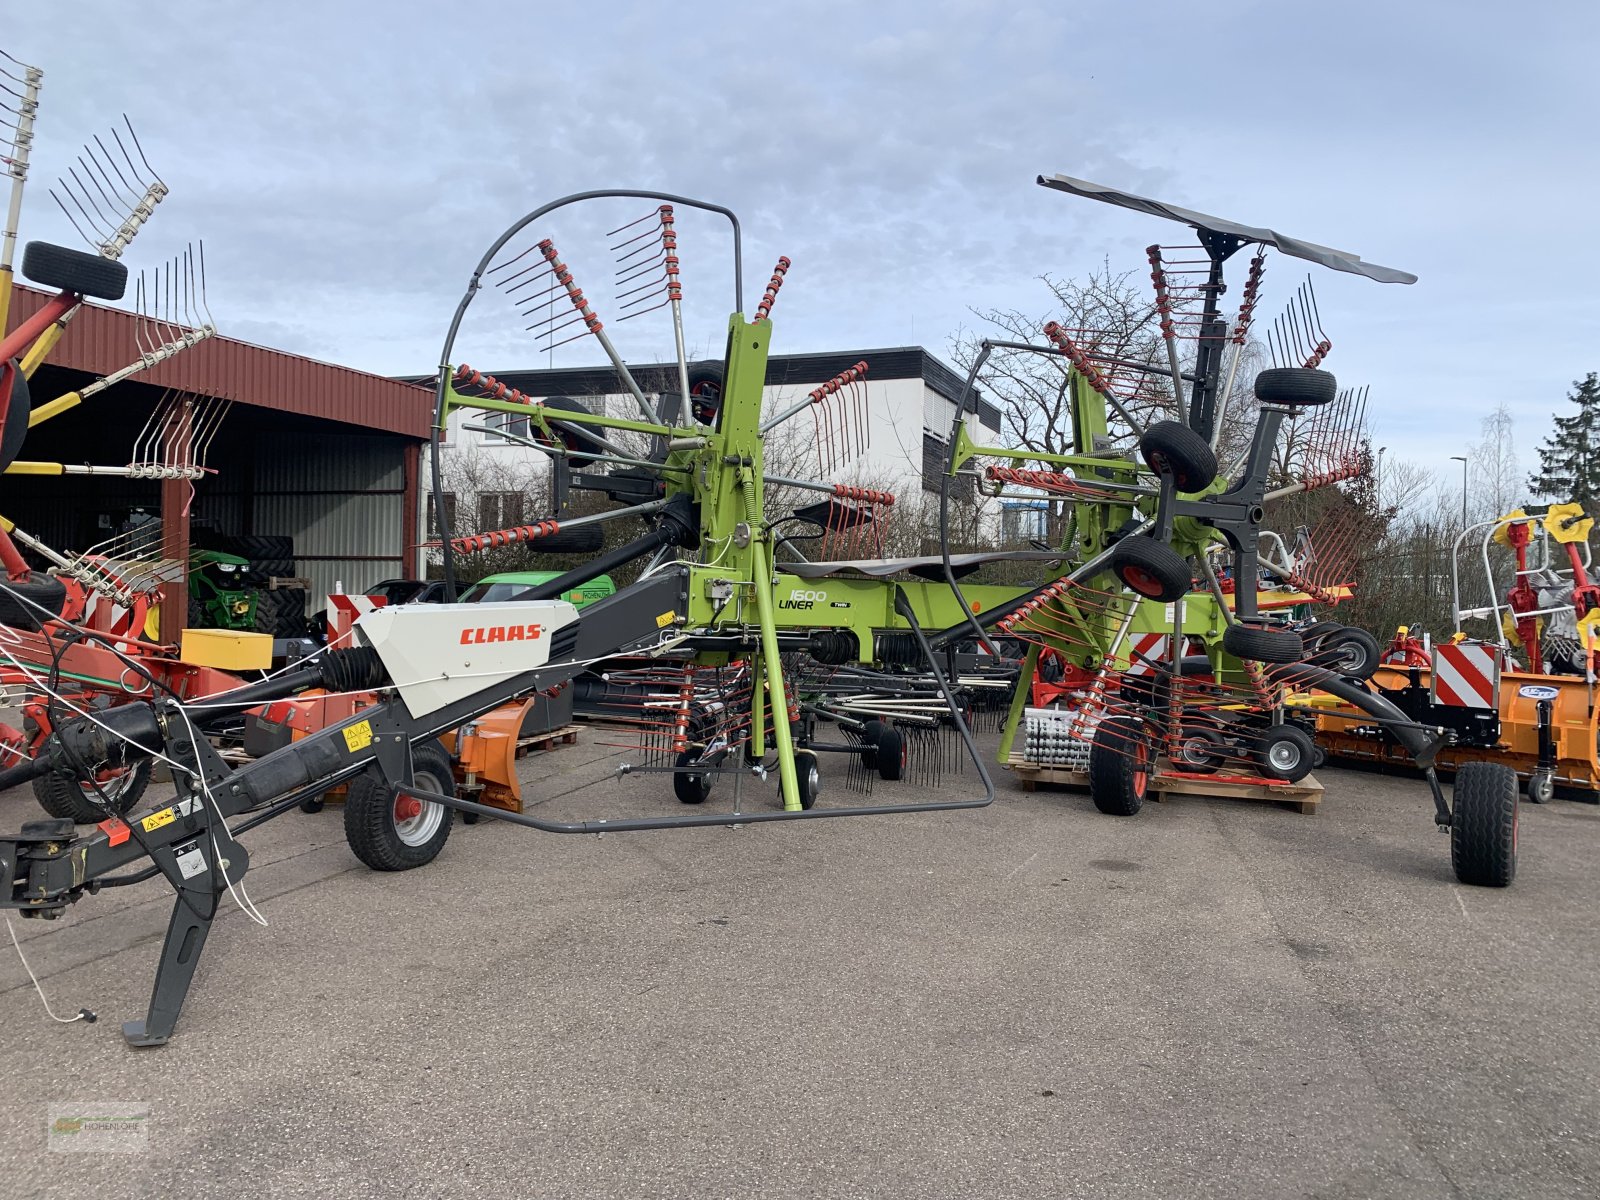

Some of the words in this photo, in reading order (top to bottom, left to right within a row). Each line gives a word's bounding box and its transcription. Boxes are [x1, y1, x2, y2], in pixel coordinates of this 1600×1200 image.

[790, 589, 827, 602] 1600
[778, 599, 813, 610] LINER
[460, 623, 541, 645] CLAAS
